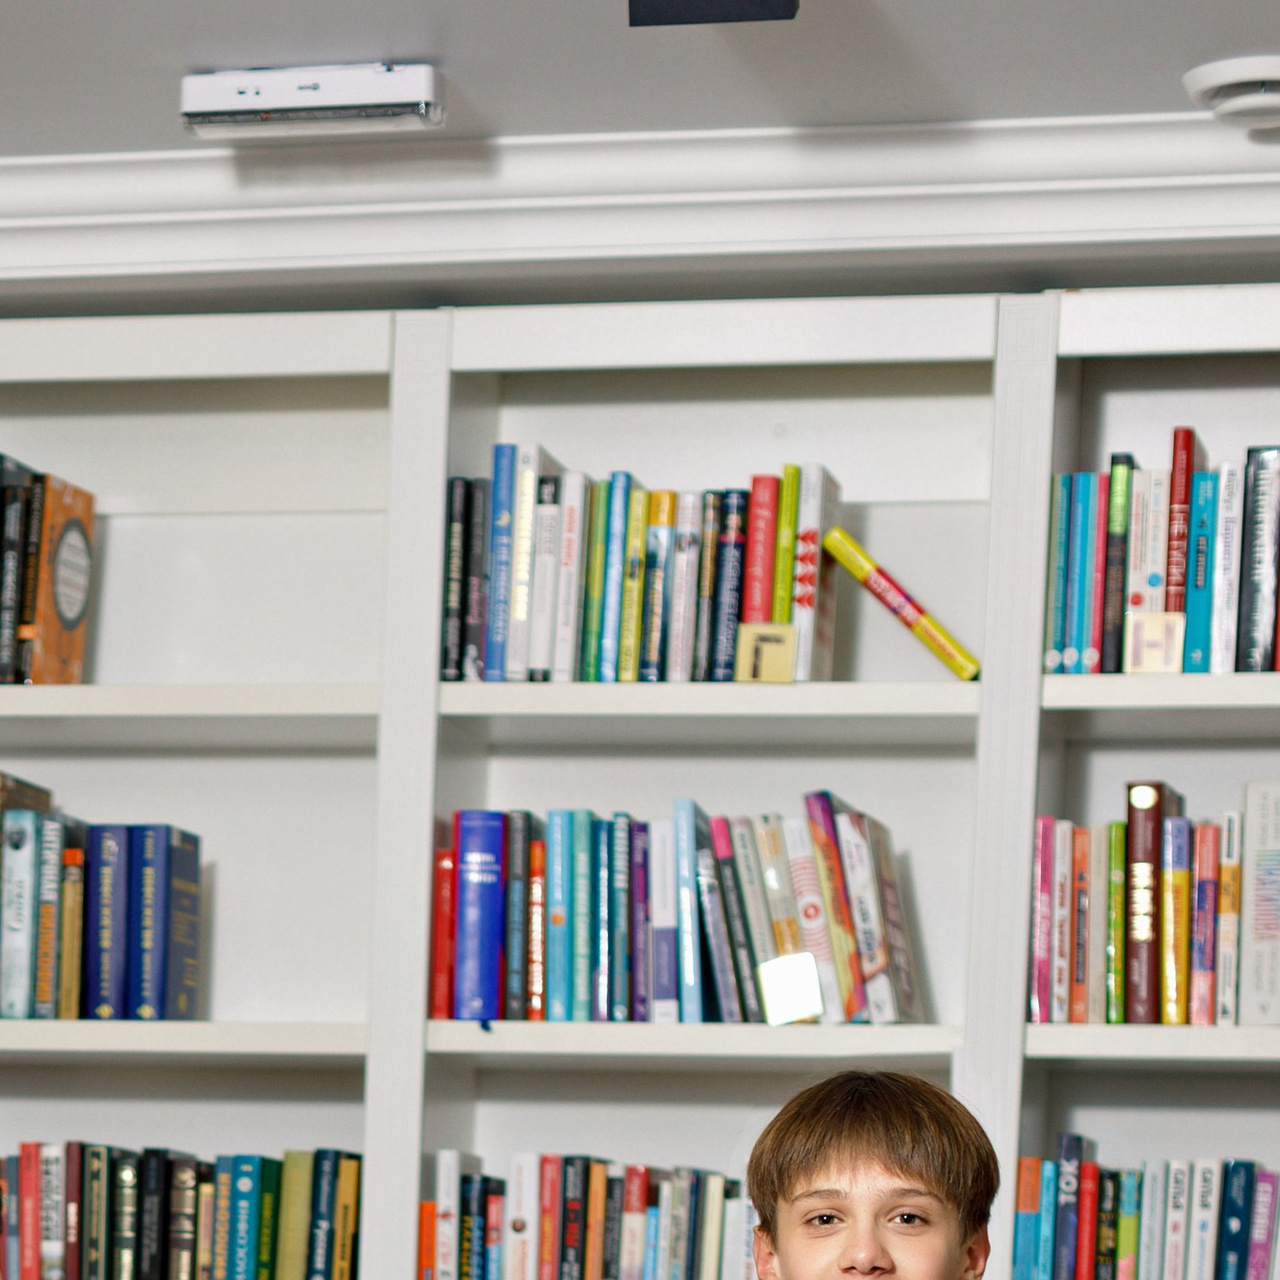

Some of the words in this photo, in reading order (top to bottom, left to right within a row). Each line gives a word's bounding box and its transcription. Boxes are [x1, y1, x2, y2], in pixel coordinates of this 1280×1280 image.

[38, 819, 61, 901] АНТИЧНАЯ
[35, 903, 56, 1003] ФИЛОСОФИЯ
[213, 1172, 232, 1280] ФИЛОСОФИЯ
